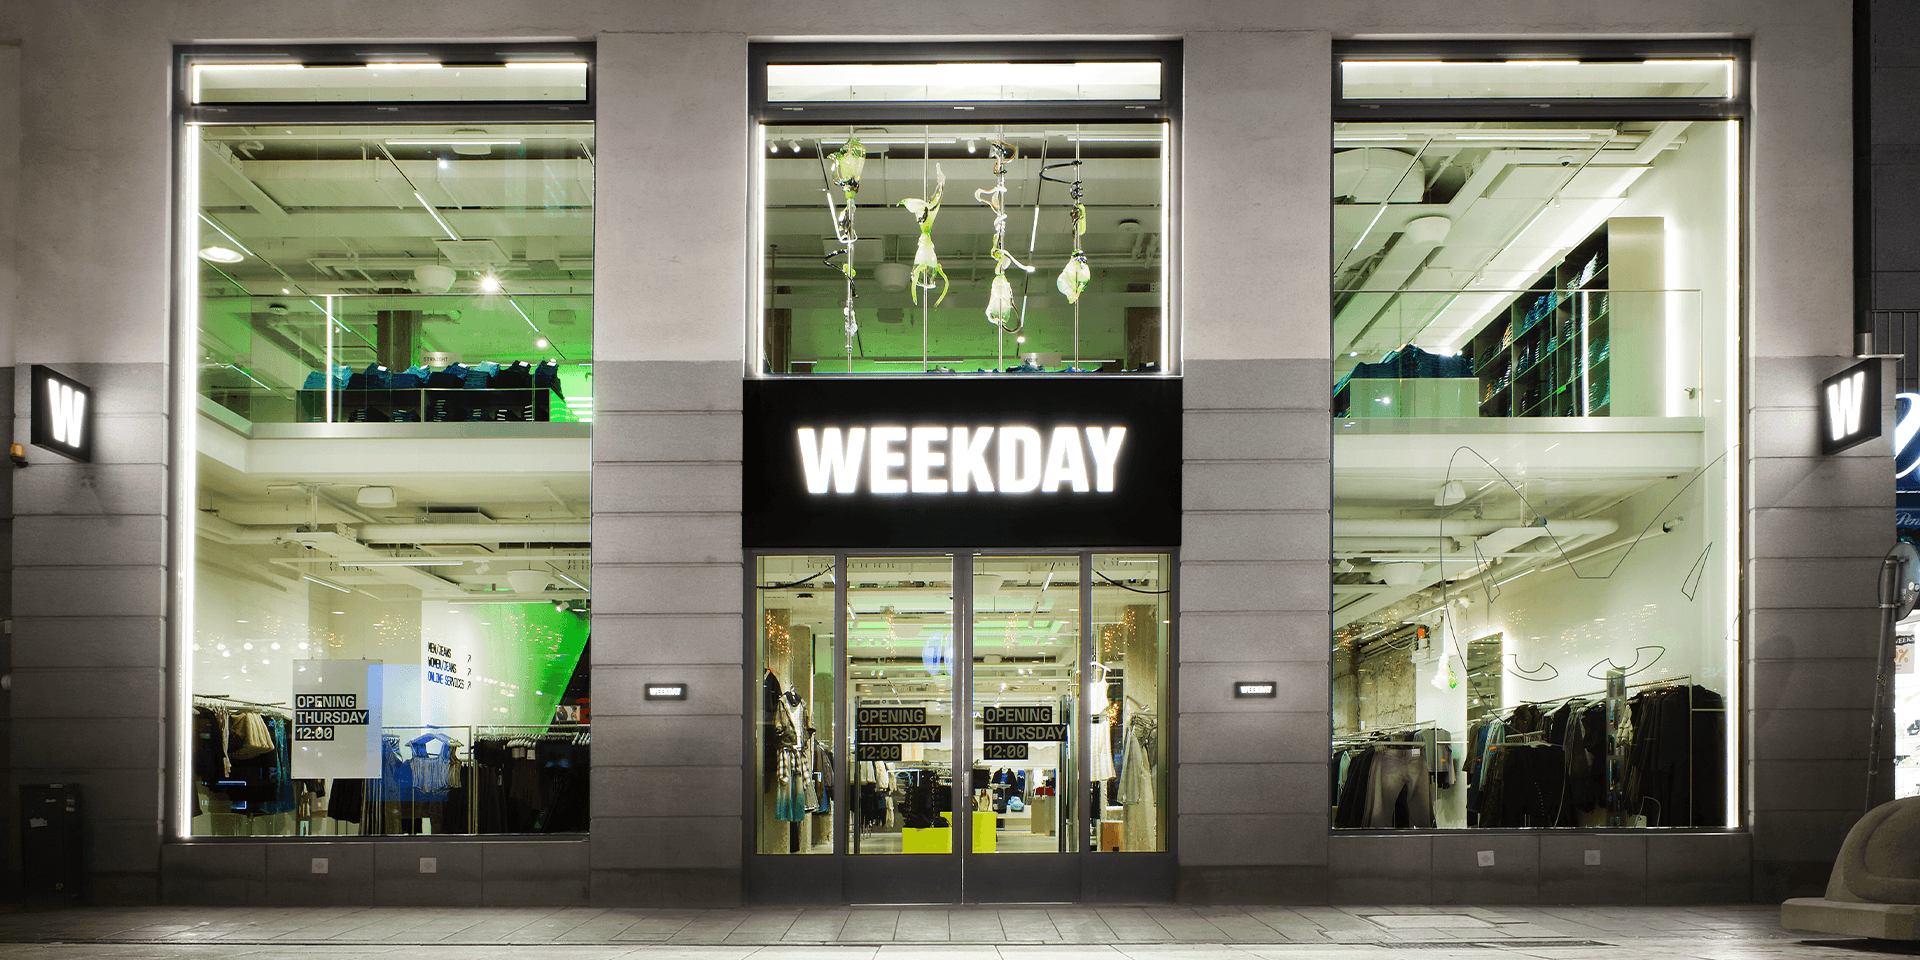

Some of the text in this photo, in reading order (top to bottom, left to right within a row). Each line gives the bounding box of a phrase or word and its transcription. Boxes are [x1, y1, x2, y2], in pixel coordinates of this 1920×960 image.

[49, 378, 85, 448] W
[1828, 371, 1864, 441] W
[798, 425, 1127, 494] WEEKDAY
[428, 642, 452, 659] MEN/JEANS
[428, 656, 457, 674] WOMEN/JEANS
[428, 670, 465, 689] ONLINE SERVICES
[649, 687, 681, 696] WEEKDAY
[1240, 686, 1272, 695] WEEKDAY
[297, 695, 355, 708] OPENING
[297, 711, 367, 723] THURSDAY
[859, 709, 924, 723] OPENING
[986, 708, 1051, 722] OPENING
[297, 727, 333, 740] 12:00
[859, 727, 940, 741] THURSDAY
[986, 726, 1066, 740] THURSDAY
[859, 746, 900, 759] 12:00
[986, 745, 1026, 758] 12:00
